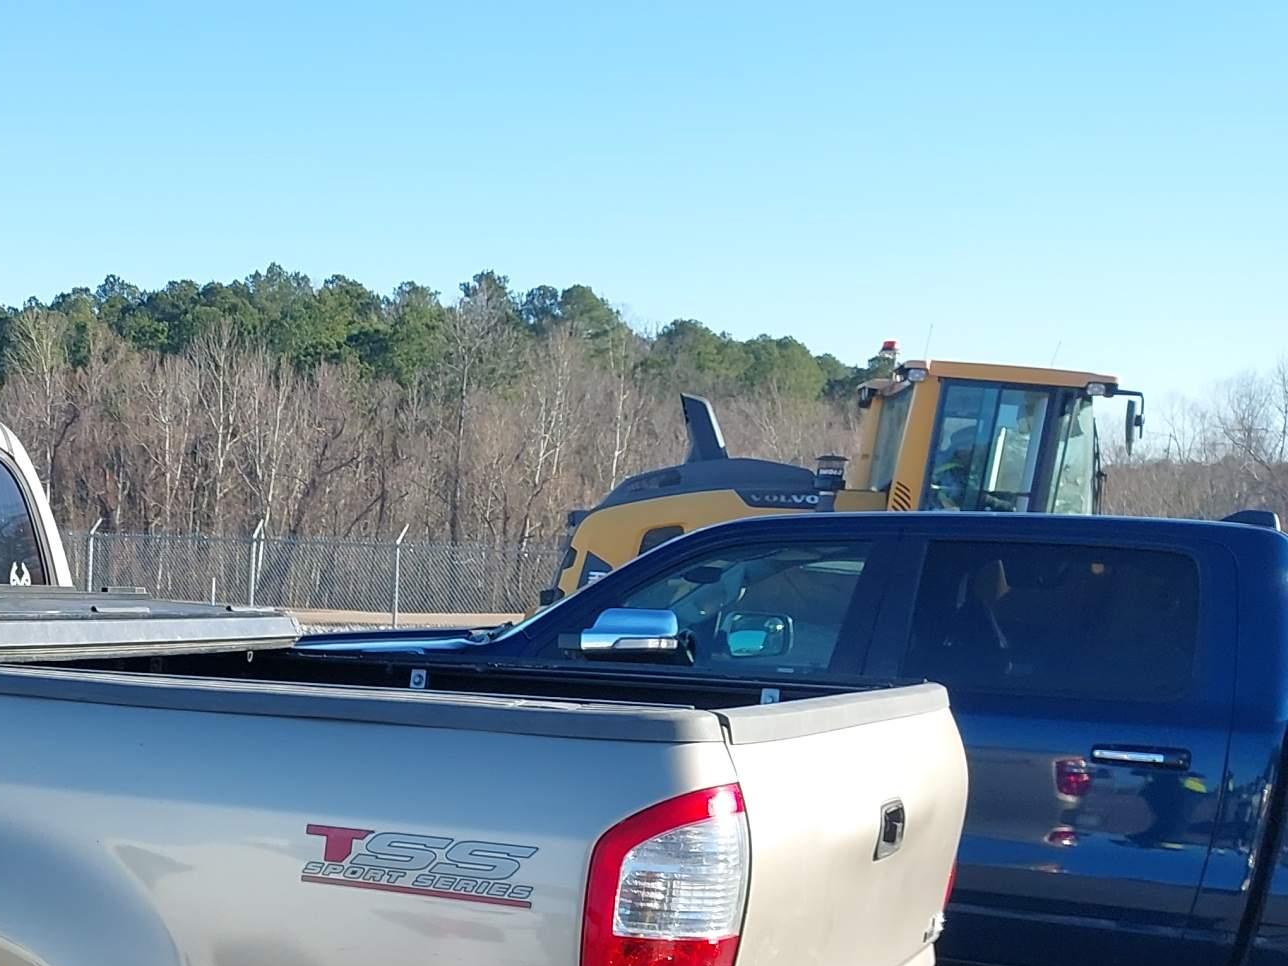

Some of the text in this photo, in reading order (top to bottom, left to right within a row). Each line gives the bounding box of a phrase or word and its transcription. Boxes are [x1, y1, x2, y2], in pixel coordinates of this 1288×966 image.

[751, 494, 819, 504] VOLVO
[306, 824, 539, 881] TSS
[302, 861, 533, 899] SPORT SERIES
